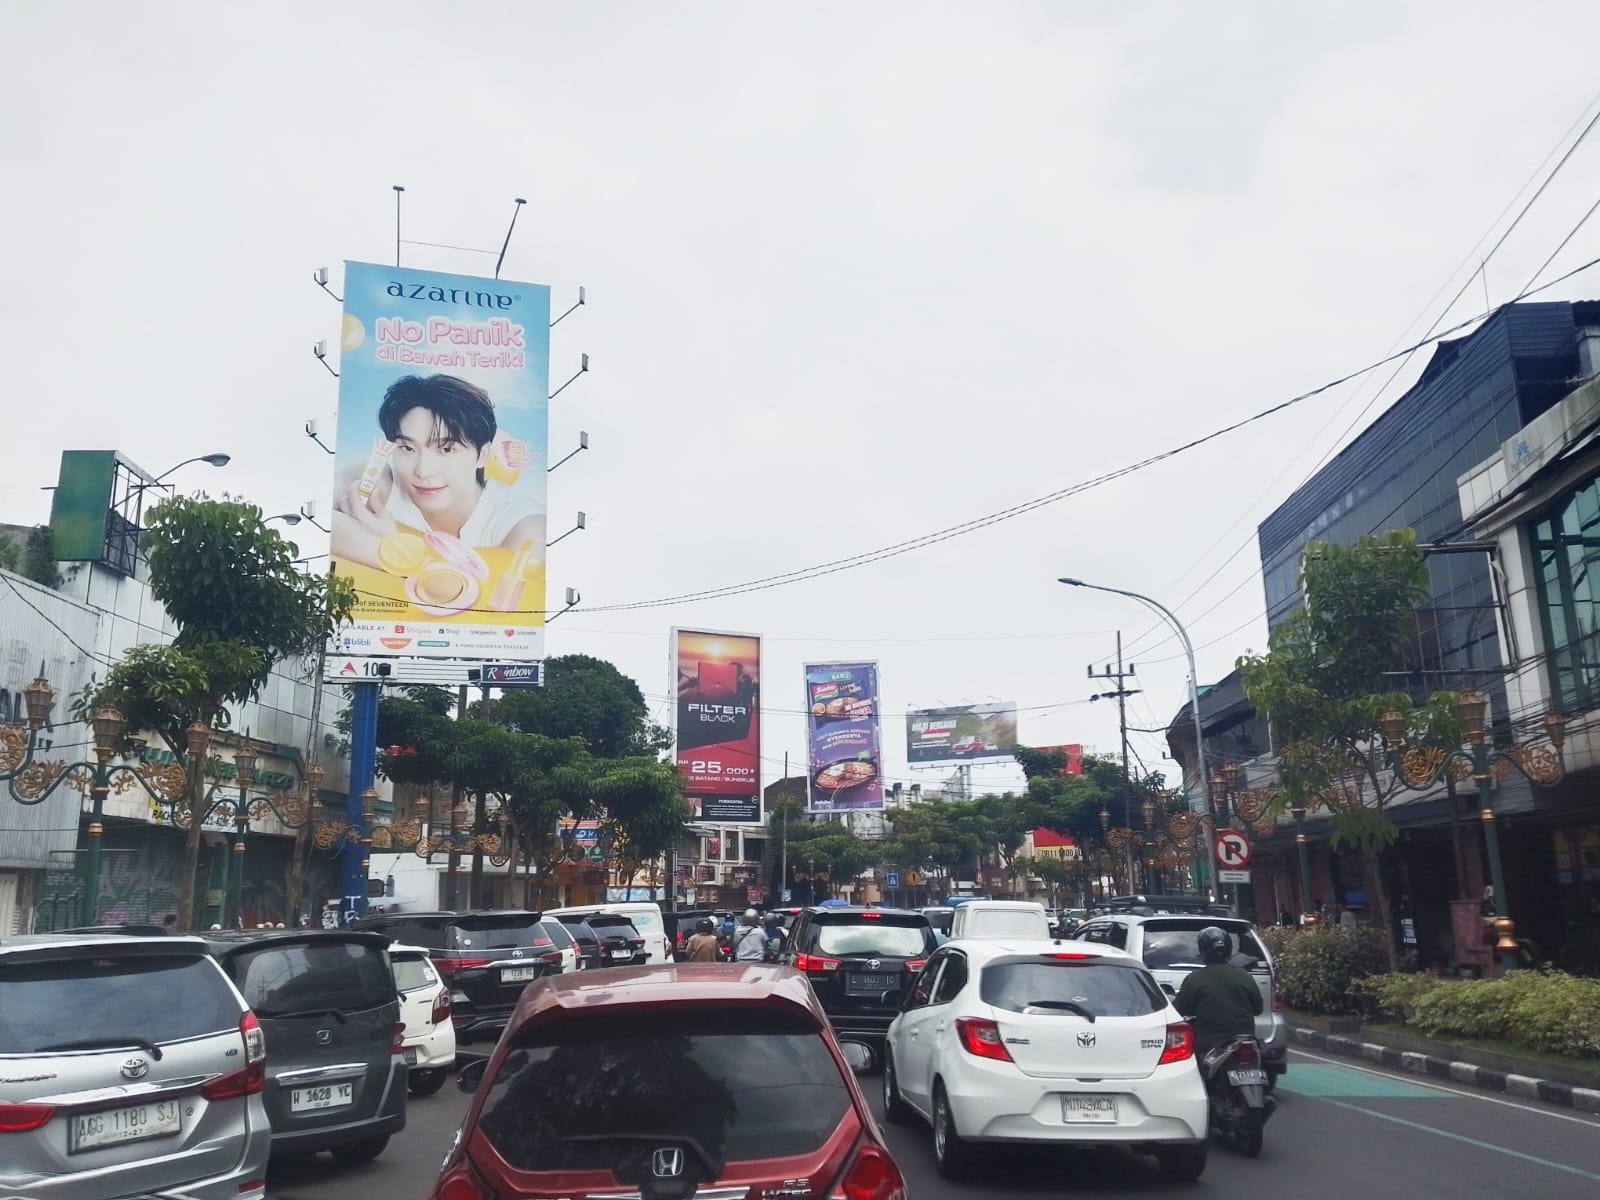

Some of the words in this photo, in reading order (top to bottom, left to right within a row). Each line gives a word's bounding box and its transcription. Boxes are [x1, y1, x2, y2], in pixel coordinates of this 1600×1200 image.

[387, 281, 513, 310] azarine
[377, 317, 424, 343] No
[428, 317, 524, 347] Panik
[377, 344, 396, 361] di
[400, 347, 466, 368] Bawah
[467, 351, 525, 369] Terik!
[368, 600, 409, 608] SEVENTEEN
[688, 703, 746, 715] FILTER
[700, 713, 736, 723] BLACK
[113, 1107, 147, 1131] 1180
[156, 1102, 175, 1122] SJ
